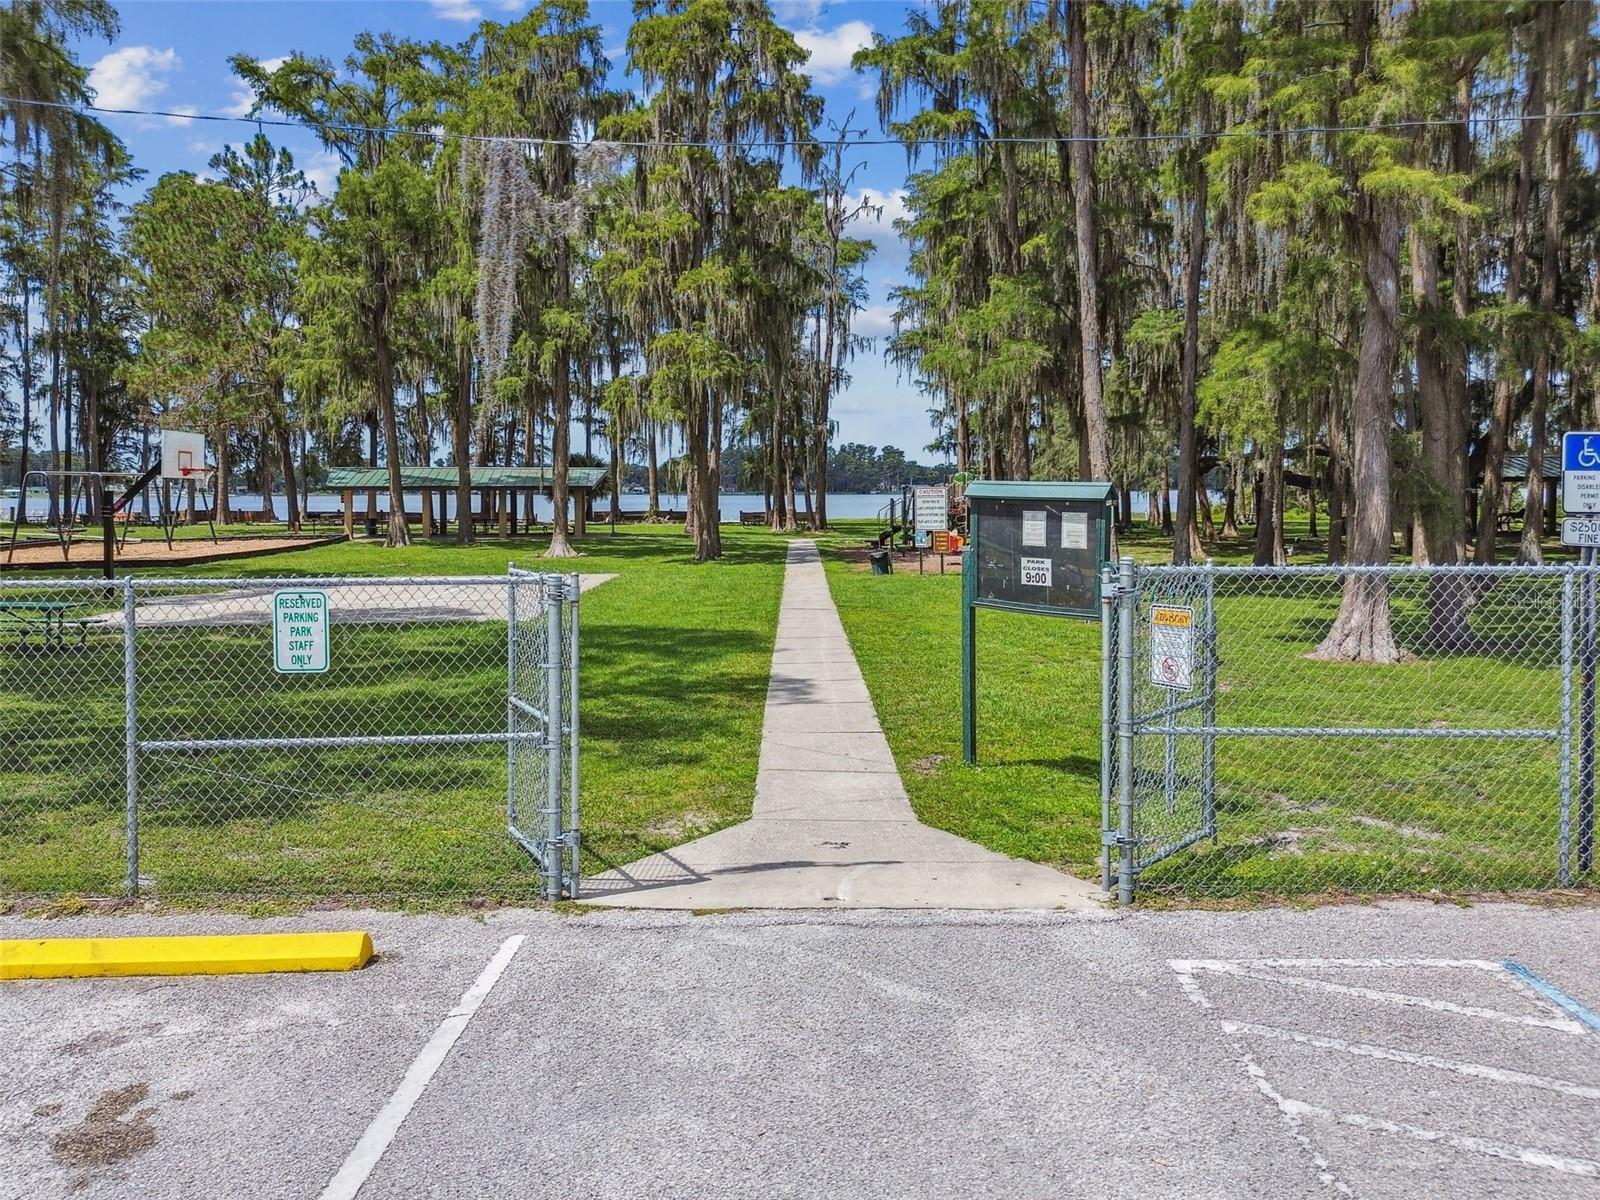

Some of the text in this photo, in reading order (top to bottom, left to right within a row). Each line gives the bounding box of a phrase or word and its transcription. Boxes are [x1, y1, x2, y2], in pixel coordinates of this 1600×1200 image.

[1578, 533, 1599, 544] FINE
[1025, 572, 1047, 584] 9:00
[279, 598, 322, 609] RESERVED
[283, 612, 319, 622] PARKING
[290, 626, 312, 637] PARK
[288, 640, 314, 651] STAFF
[291, 654, 312, 665] ONLY
